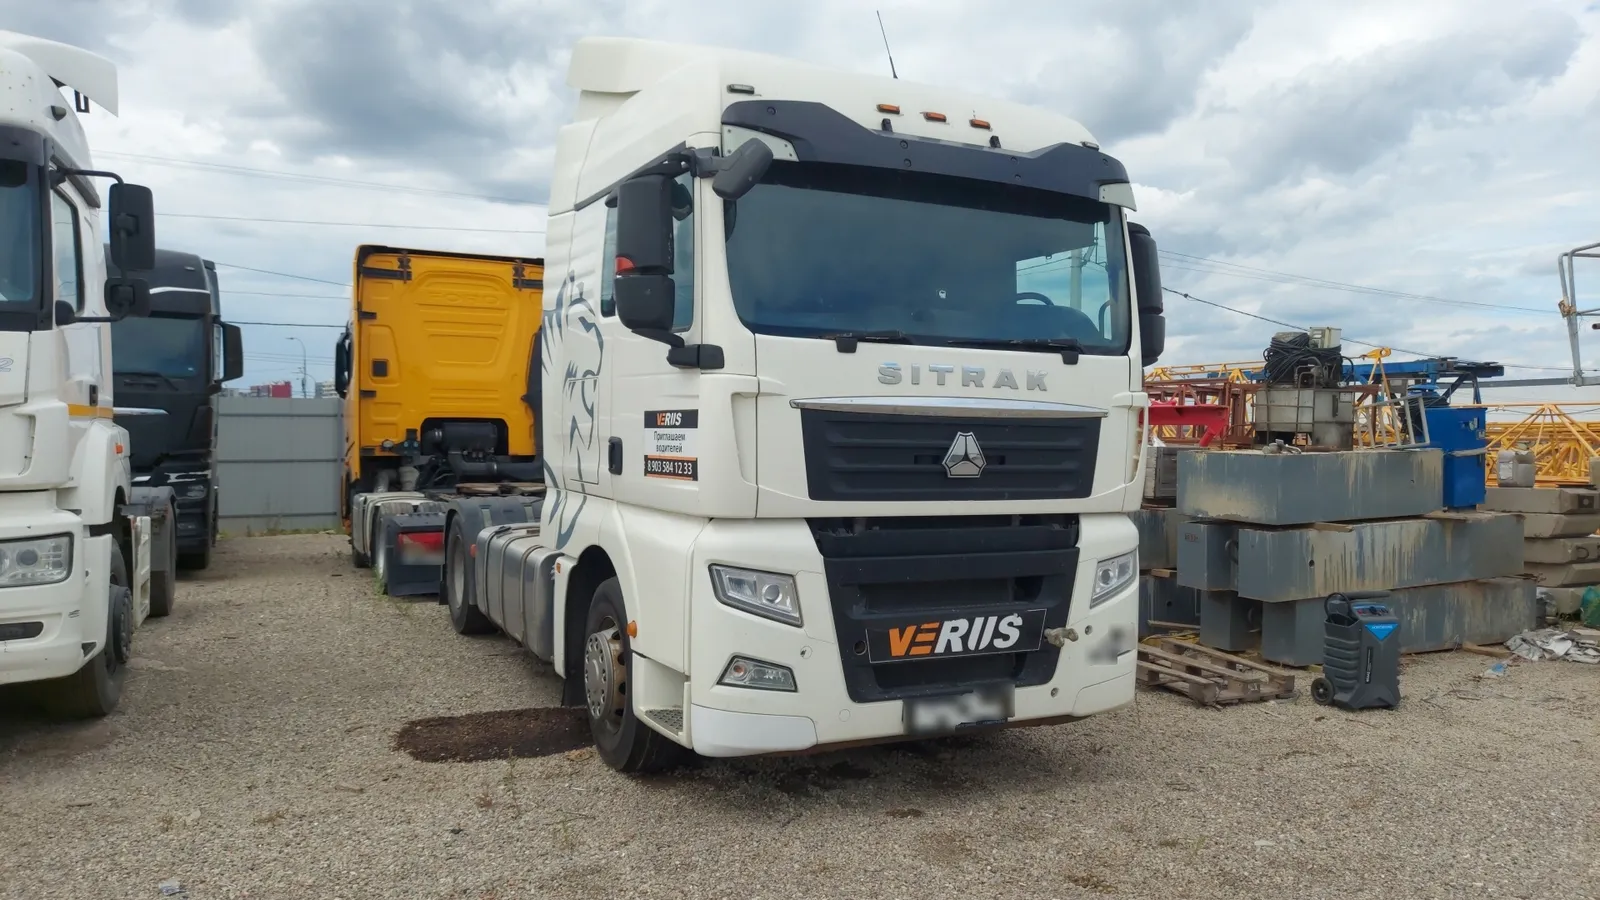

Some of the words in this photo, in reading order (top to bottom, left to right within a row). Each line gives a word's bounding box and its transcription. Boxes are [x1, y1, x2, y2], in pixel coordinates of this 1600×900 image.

[877, 362, 1049, 392] SITRAK
[654, 430, 685, 442] Приглашаем
[656, 443, 683, 453] водителей
[647, 460, 652, 472] 8
[652, 460, 662, 472] 903
[662, 461, 674, 473] 584
[674, 462, 683, 474] 12
[683, 462, 693, 475] 33
